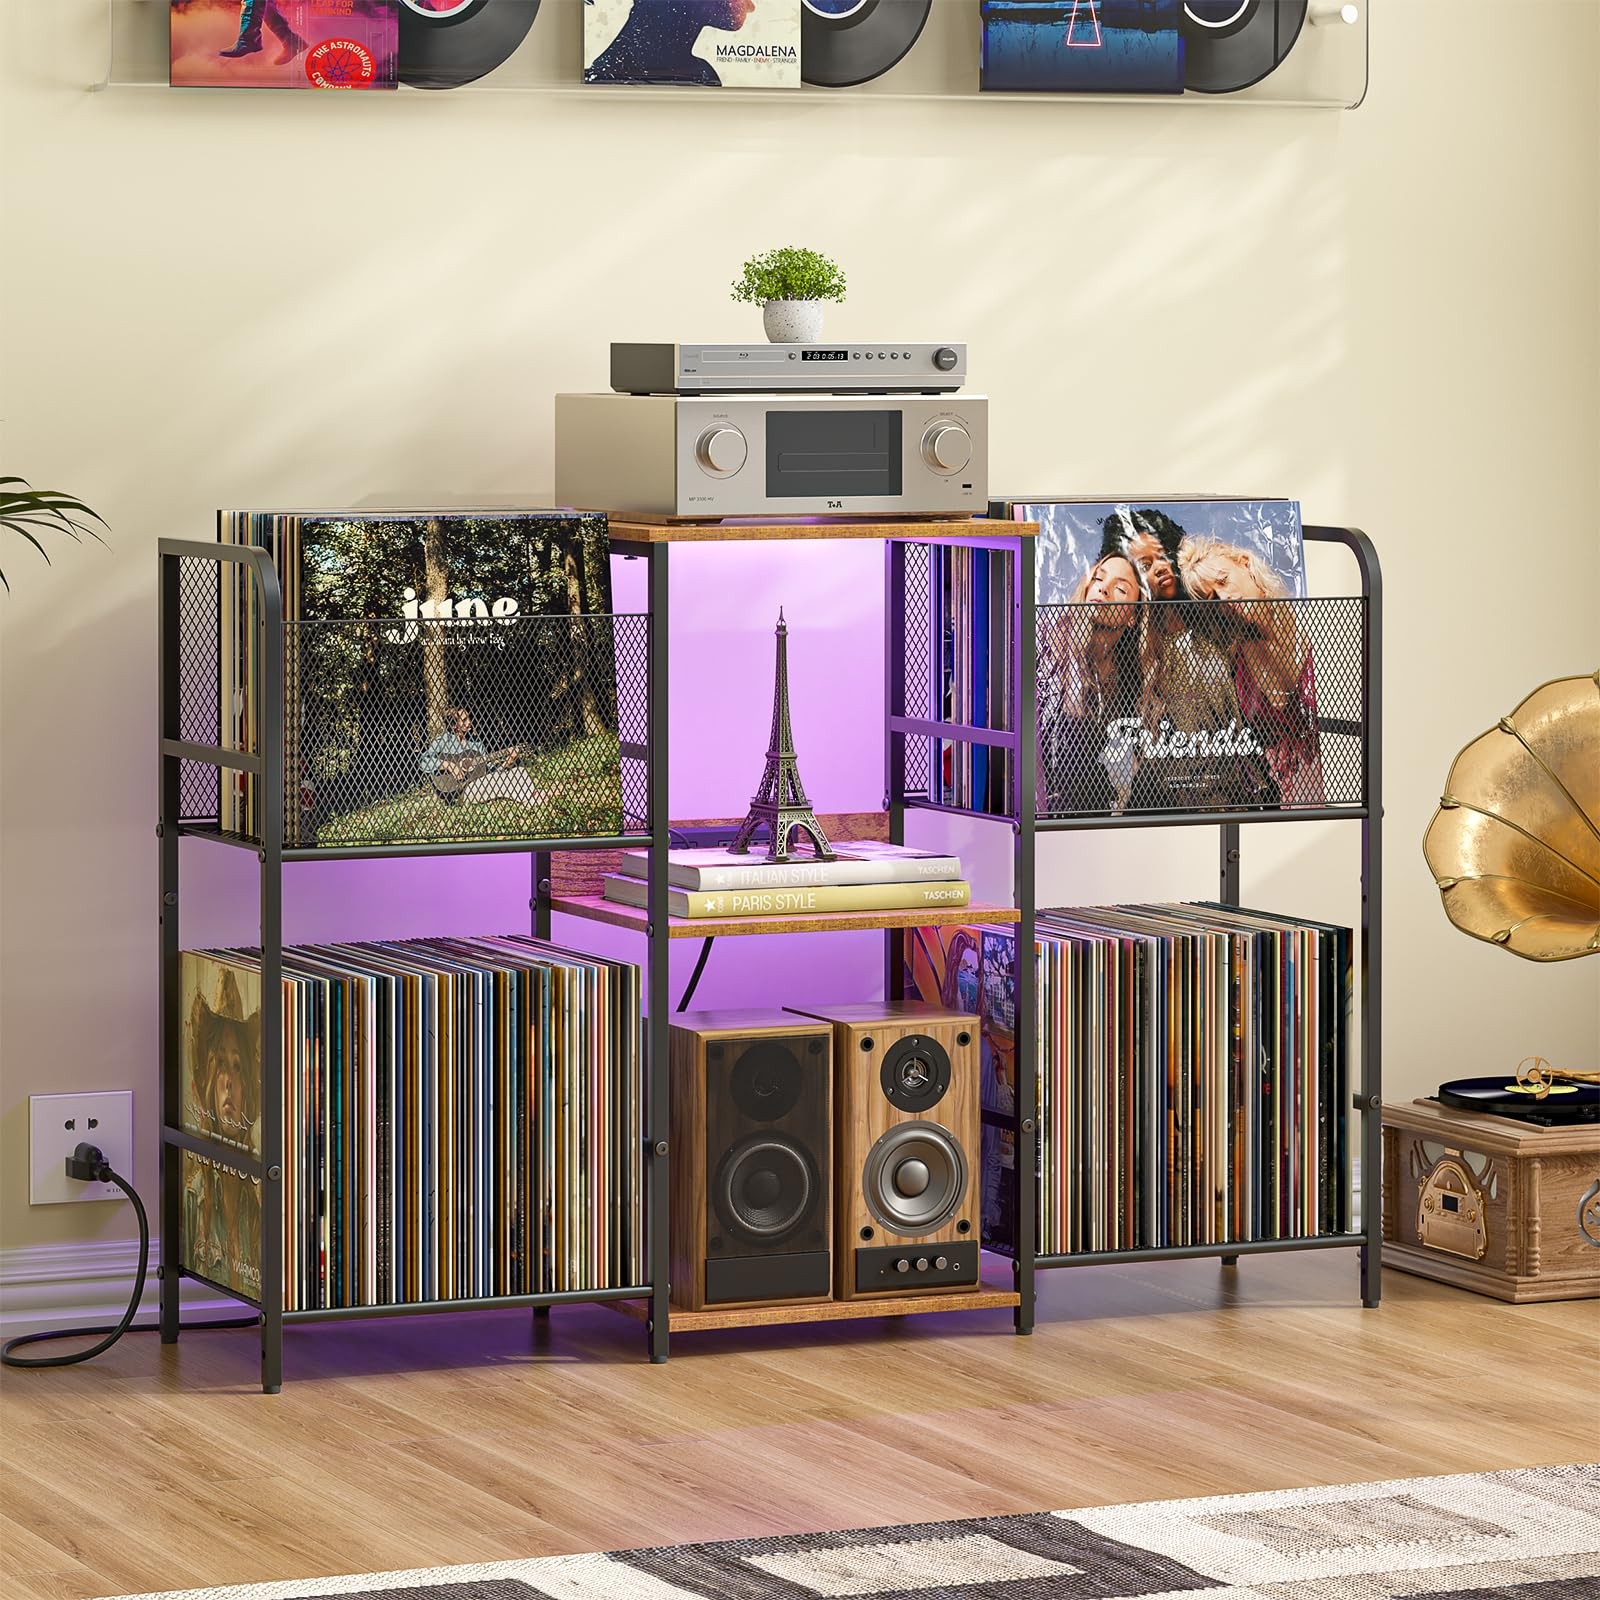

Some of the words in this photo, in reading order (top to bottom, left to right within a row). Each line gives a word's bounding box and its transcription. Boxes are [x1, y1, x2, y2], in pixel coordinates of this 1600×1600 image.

[336, 0, 354, 8] FOR
[716, 45, 796, 57] MAGDALENA
[312, 45, 330, 59] THE
[330, 41, 372, 77] ASTRONAUTS
[384, 587, 521, 645] june
[740, 868, 787, 885] ITALIAN
[791, 866, 829, 883] STYLE
[918, 864, 955, 874] TASCHEN
[732, 894, 772, 912] PARIS
[775, 893, 816, 910] STYLE
[923, 890, 964, 900] TASCHEN
